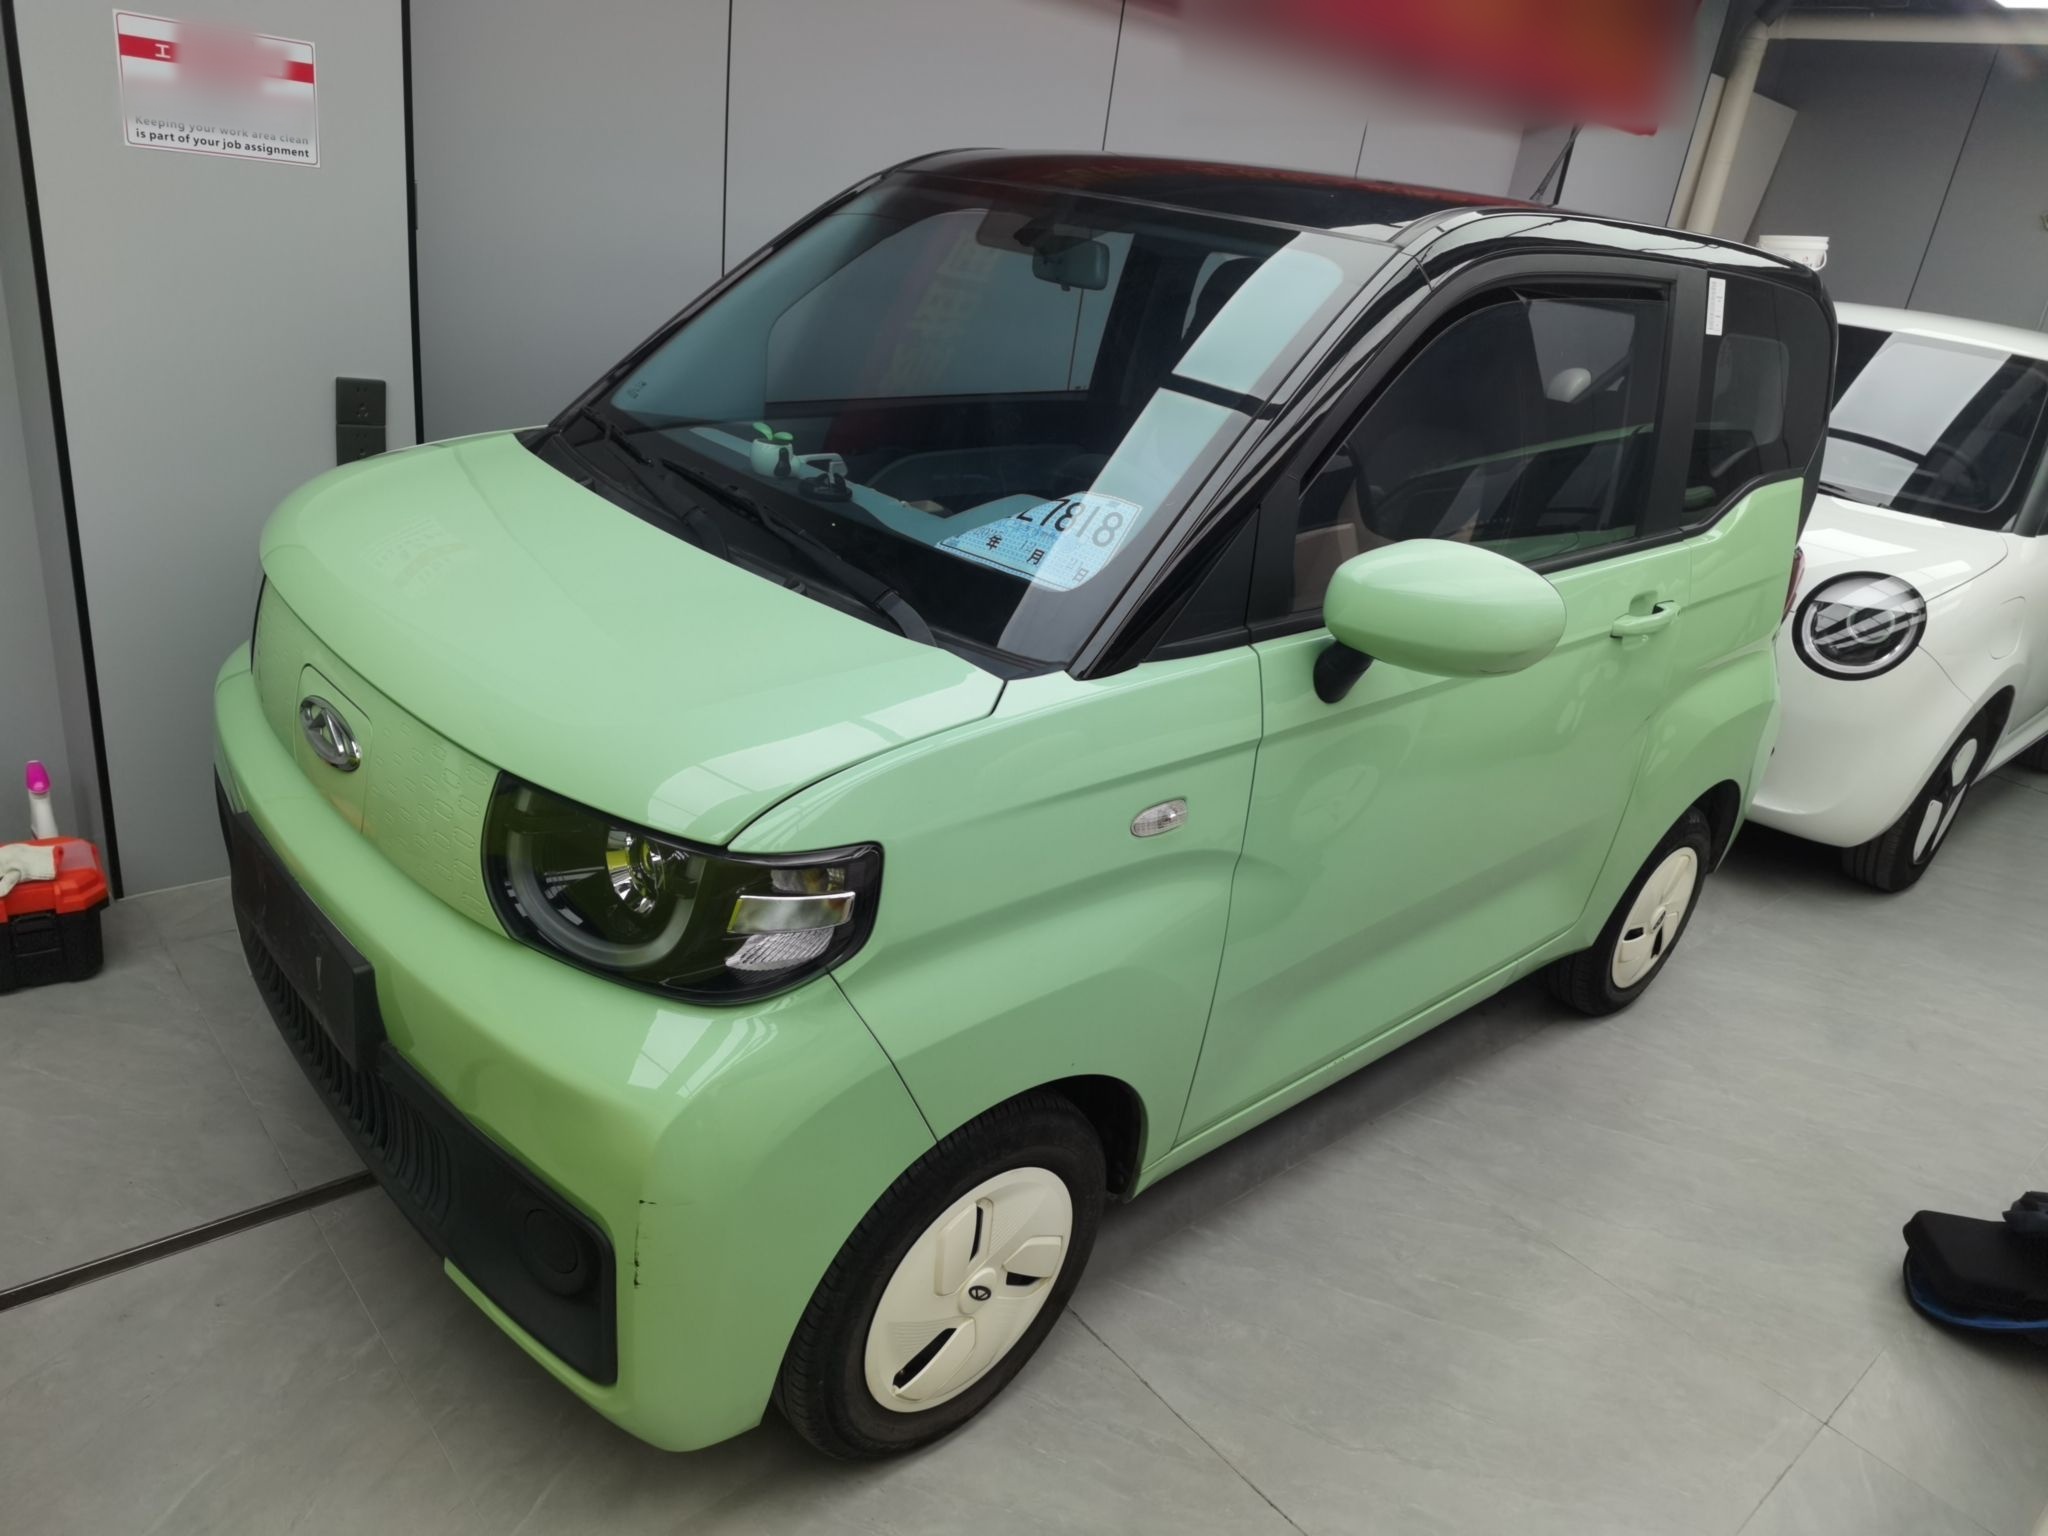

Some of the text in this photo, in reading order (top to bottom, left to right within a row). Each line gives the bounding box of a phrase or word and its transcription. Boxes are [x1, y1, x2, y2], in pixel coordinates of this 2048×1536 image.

[135, 115, 309, 145] Keeping your work area clean
[135, 127, 310, 158] is part of your job assignment
[986, 534, 1002, 550] 年
[1026, 548, 1045, 566] 月
